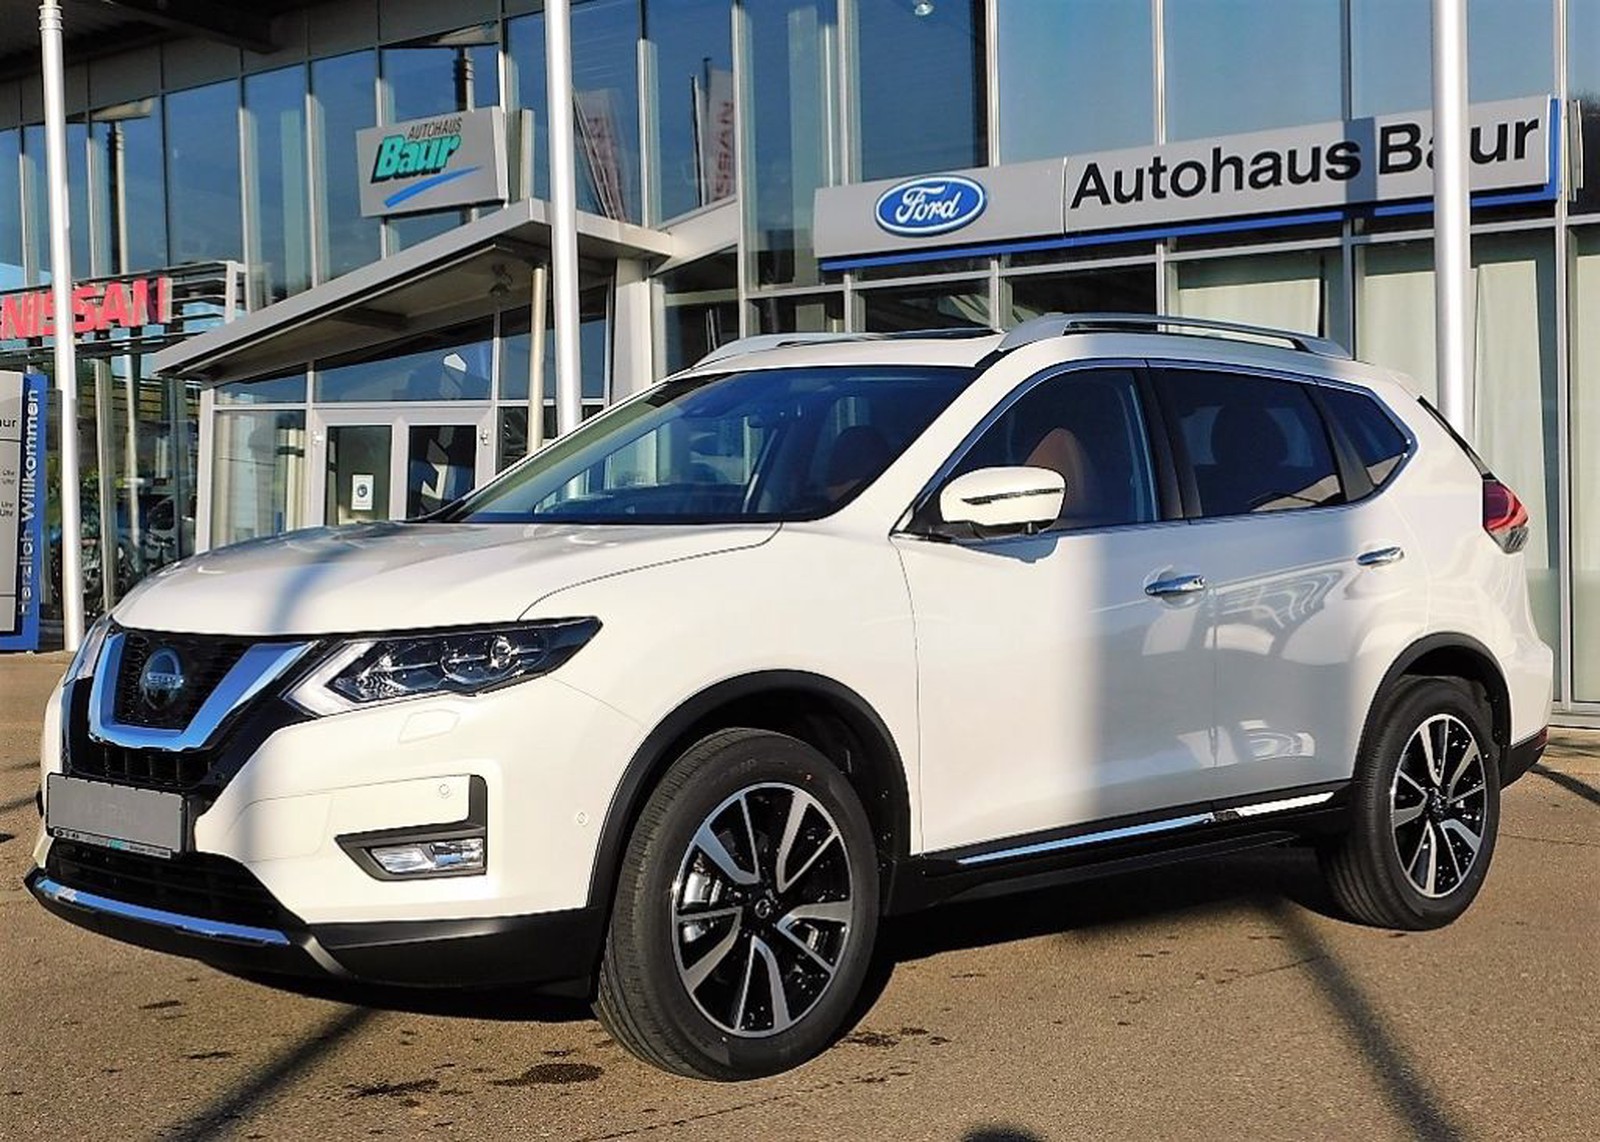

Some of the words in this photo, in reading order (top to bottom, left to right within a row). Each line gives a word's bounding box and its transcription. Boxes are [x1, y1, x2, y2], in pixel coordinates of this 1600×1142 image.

[371, 134, 462, 183] Baur
[407, 118, 463, 140] AUTOHAUS
[714, 100, 735, 200] SSAN
[1070, 138, 1363, 210] Autohaus
[1378, 117, 1539, 176] Bur
[895, 185, 962, 225] Ford
[0, 418, 17, 428] ur
[21, 389, 39, 522] Willkommen
[18, 526, 34, 616] Herzlich
